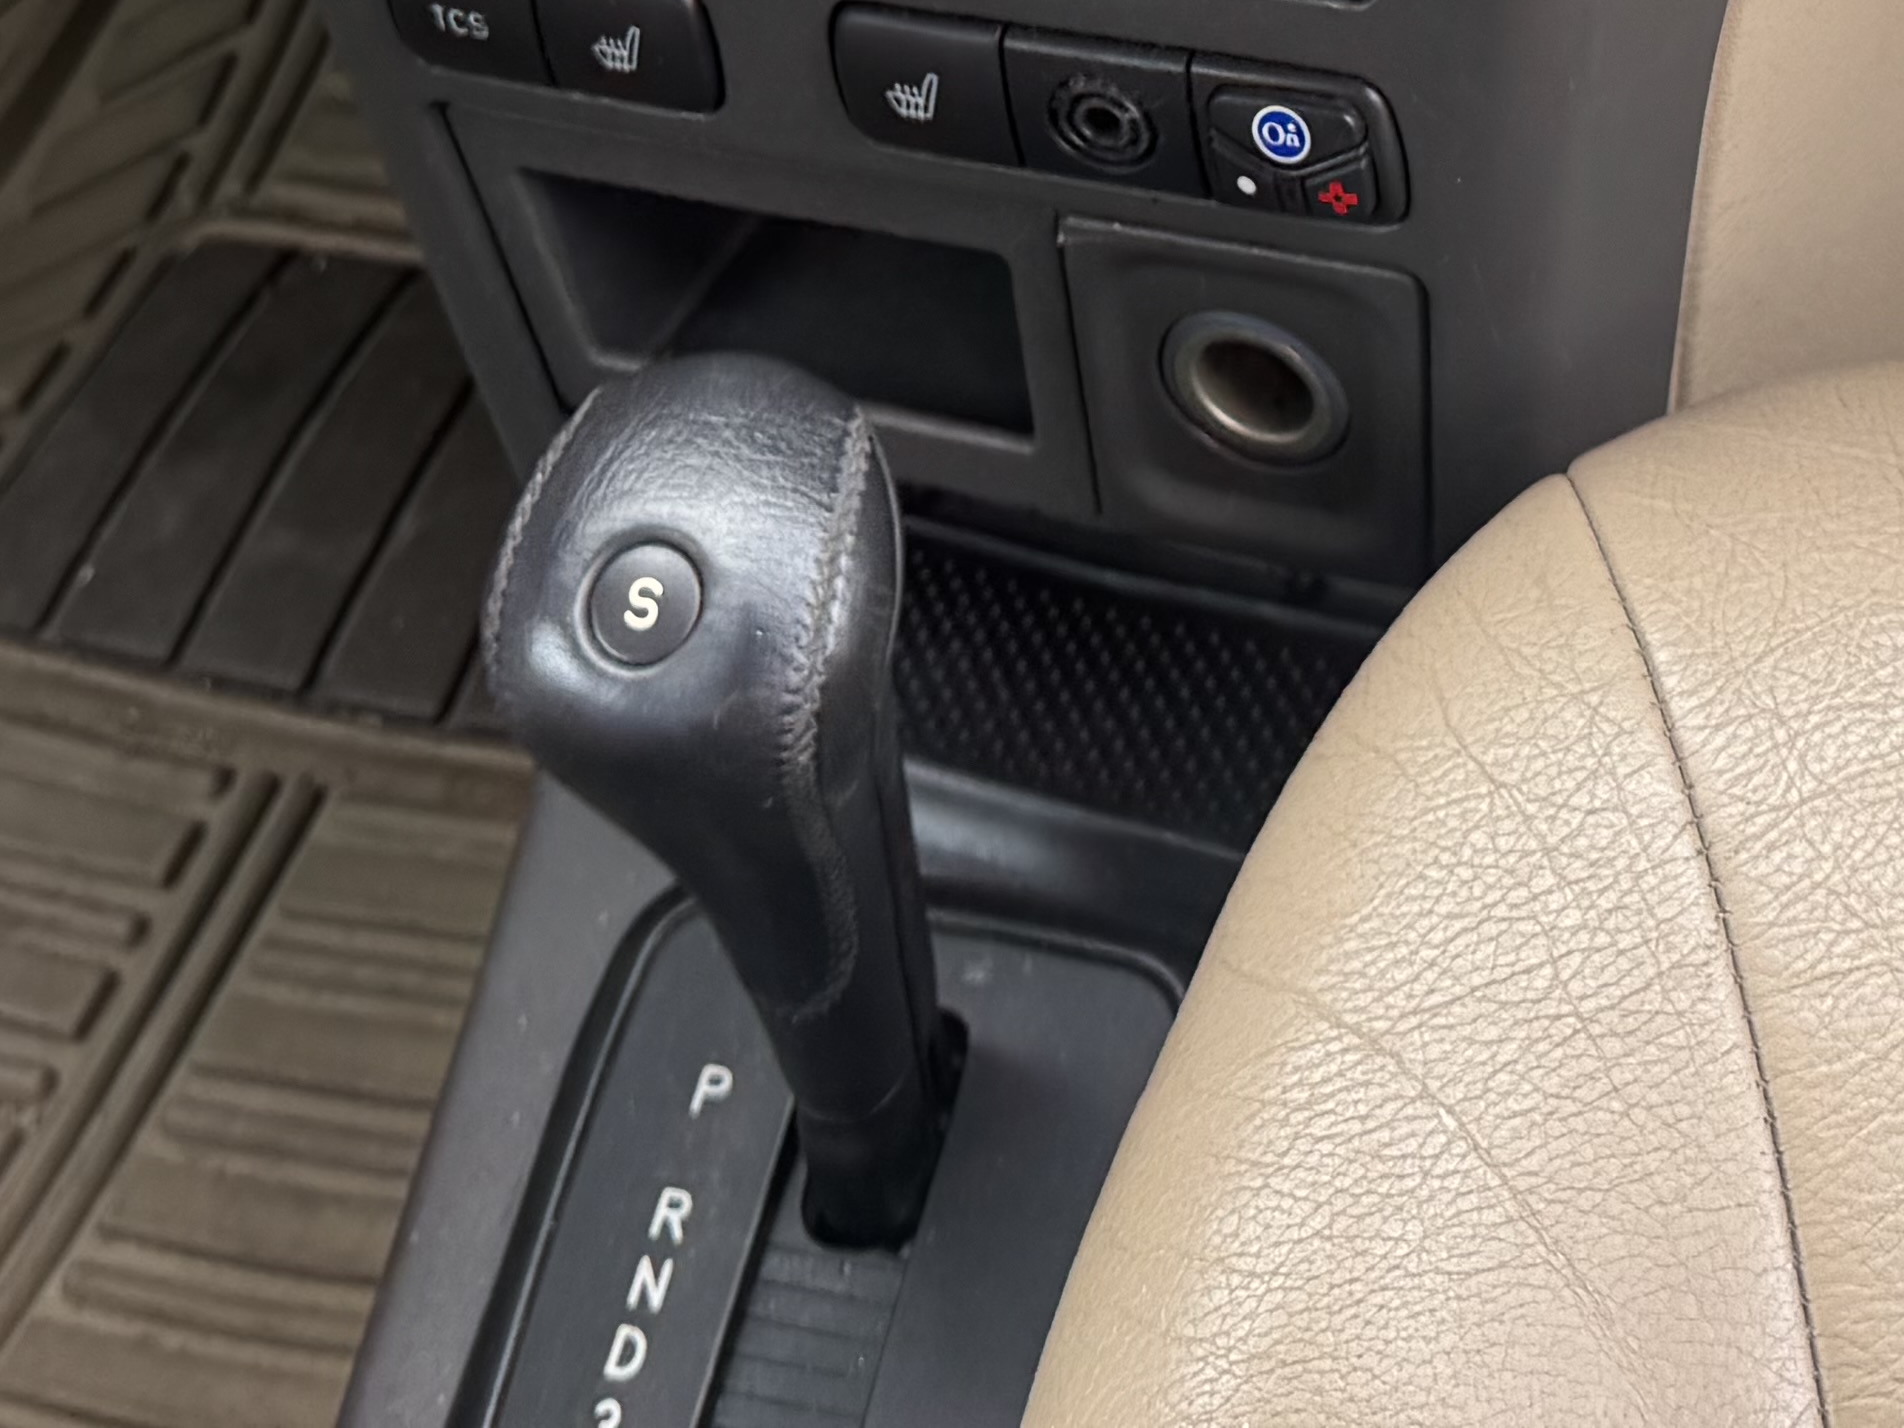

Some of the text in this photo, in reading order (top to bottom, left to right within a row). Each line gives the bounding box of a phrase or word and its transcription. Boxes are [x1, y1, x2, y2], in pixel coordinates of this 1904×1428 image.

[623, 576, 665, 632] S
[689, 1063, 734, 1119] P
[648, 1186, 694, 1245] R
[626, 1254, 674, 1315] N
[603, 1322, 648, 1383] D
